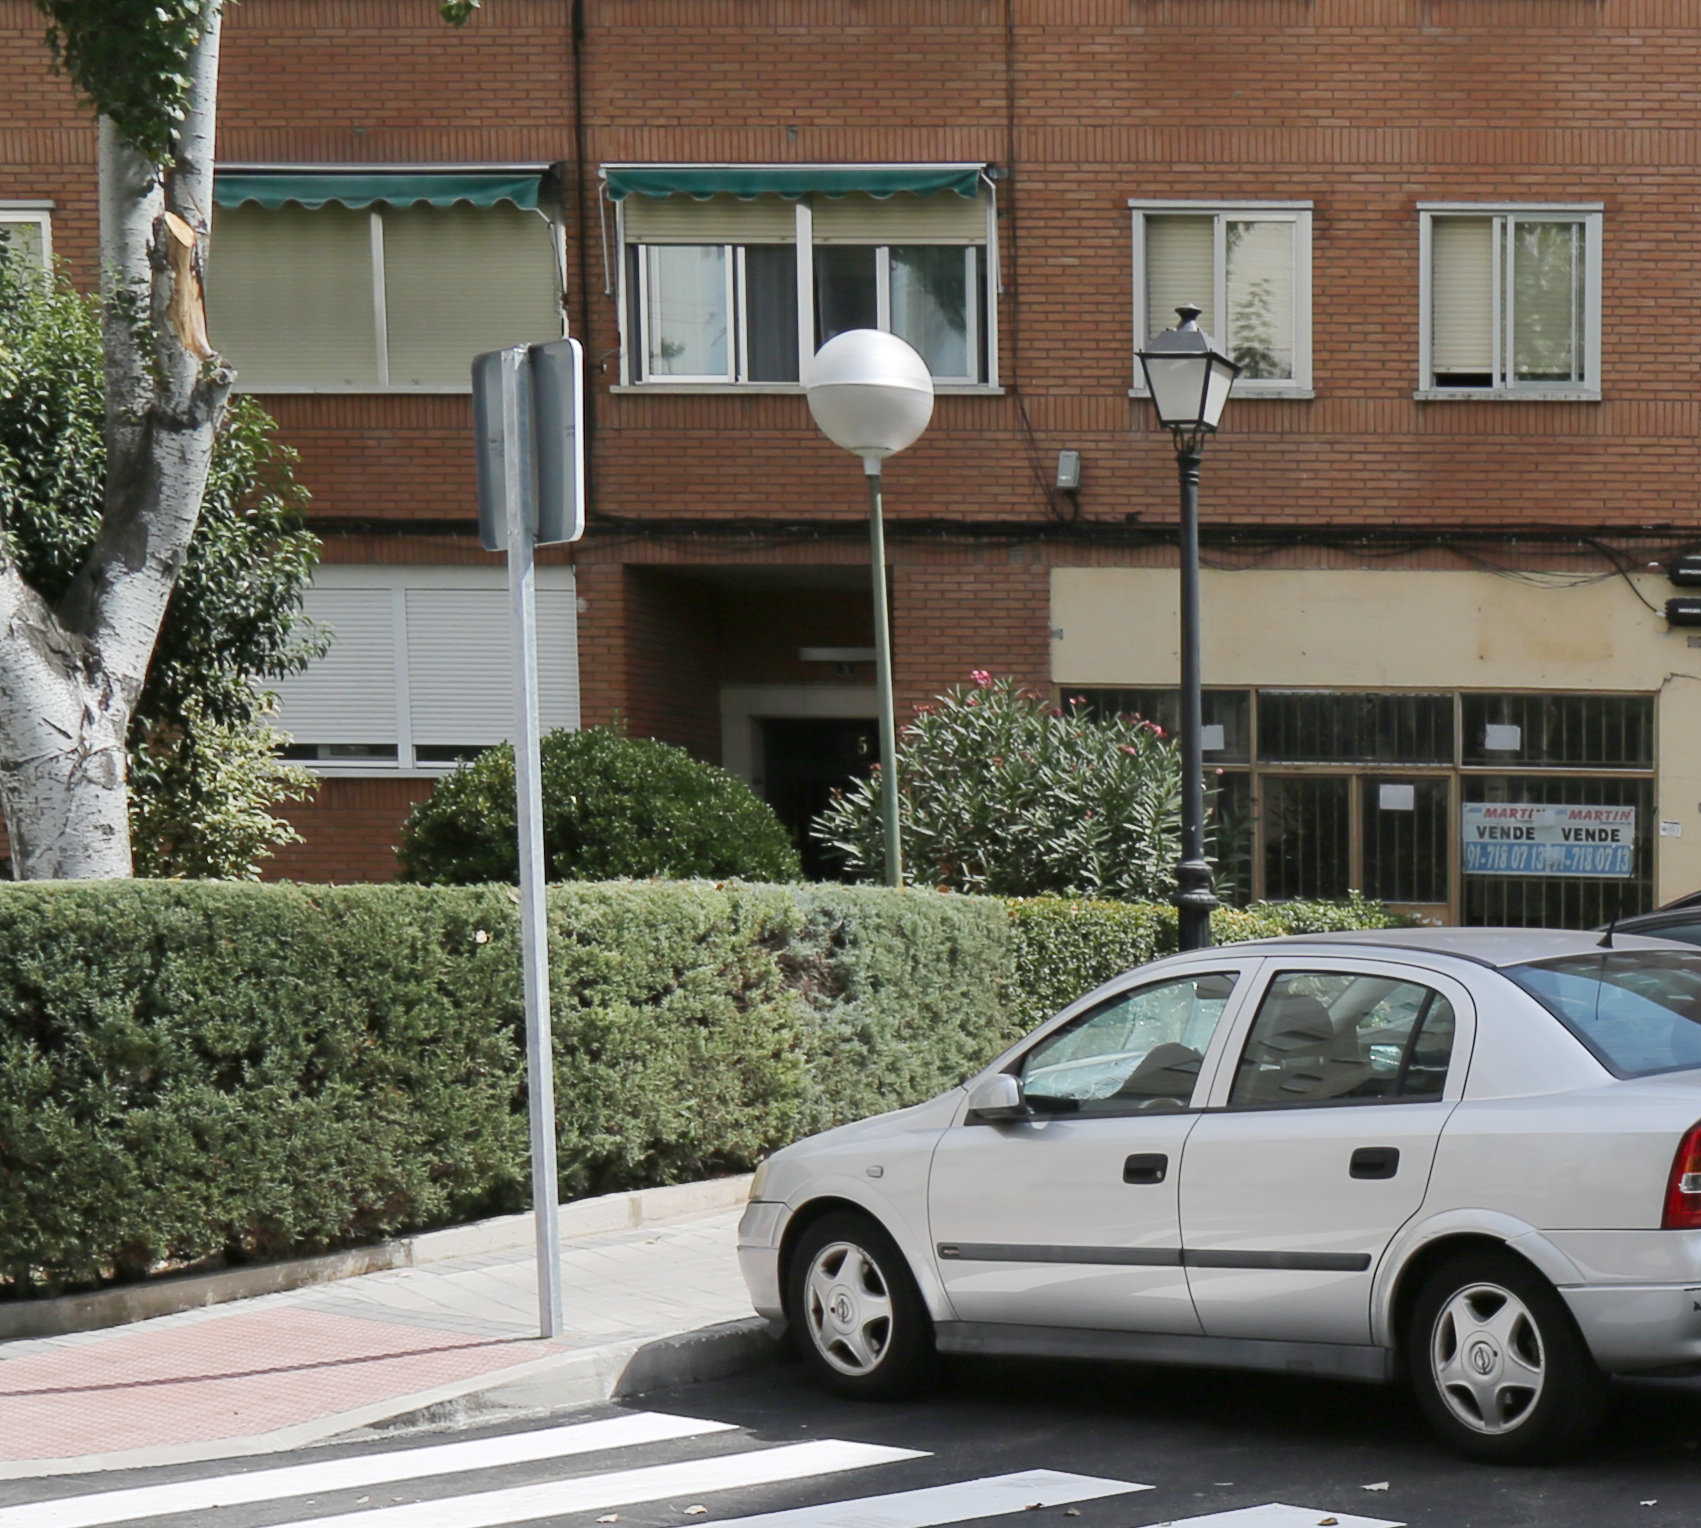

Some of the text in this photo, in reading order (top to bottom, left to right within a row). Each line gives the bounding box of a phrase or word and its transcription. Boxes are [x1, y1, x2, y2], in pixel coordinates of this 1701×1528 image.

[859, 737, 867, 754] 5
[1484, 808, 1545, 819] MARTI
[1568, 810, 1632, 821] MARTIN
[1476, 826, 1535, 840] VENDE
[1561, 827, 1620, 842] VENDE
[1467, 845, 1544, 869] 91-718 07 13
[1595, 847, 1613, 872] 07
[1617, 847, 1630, 871] 13
